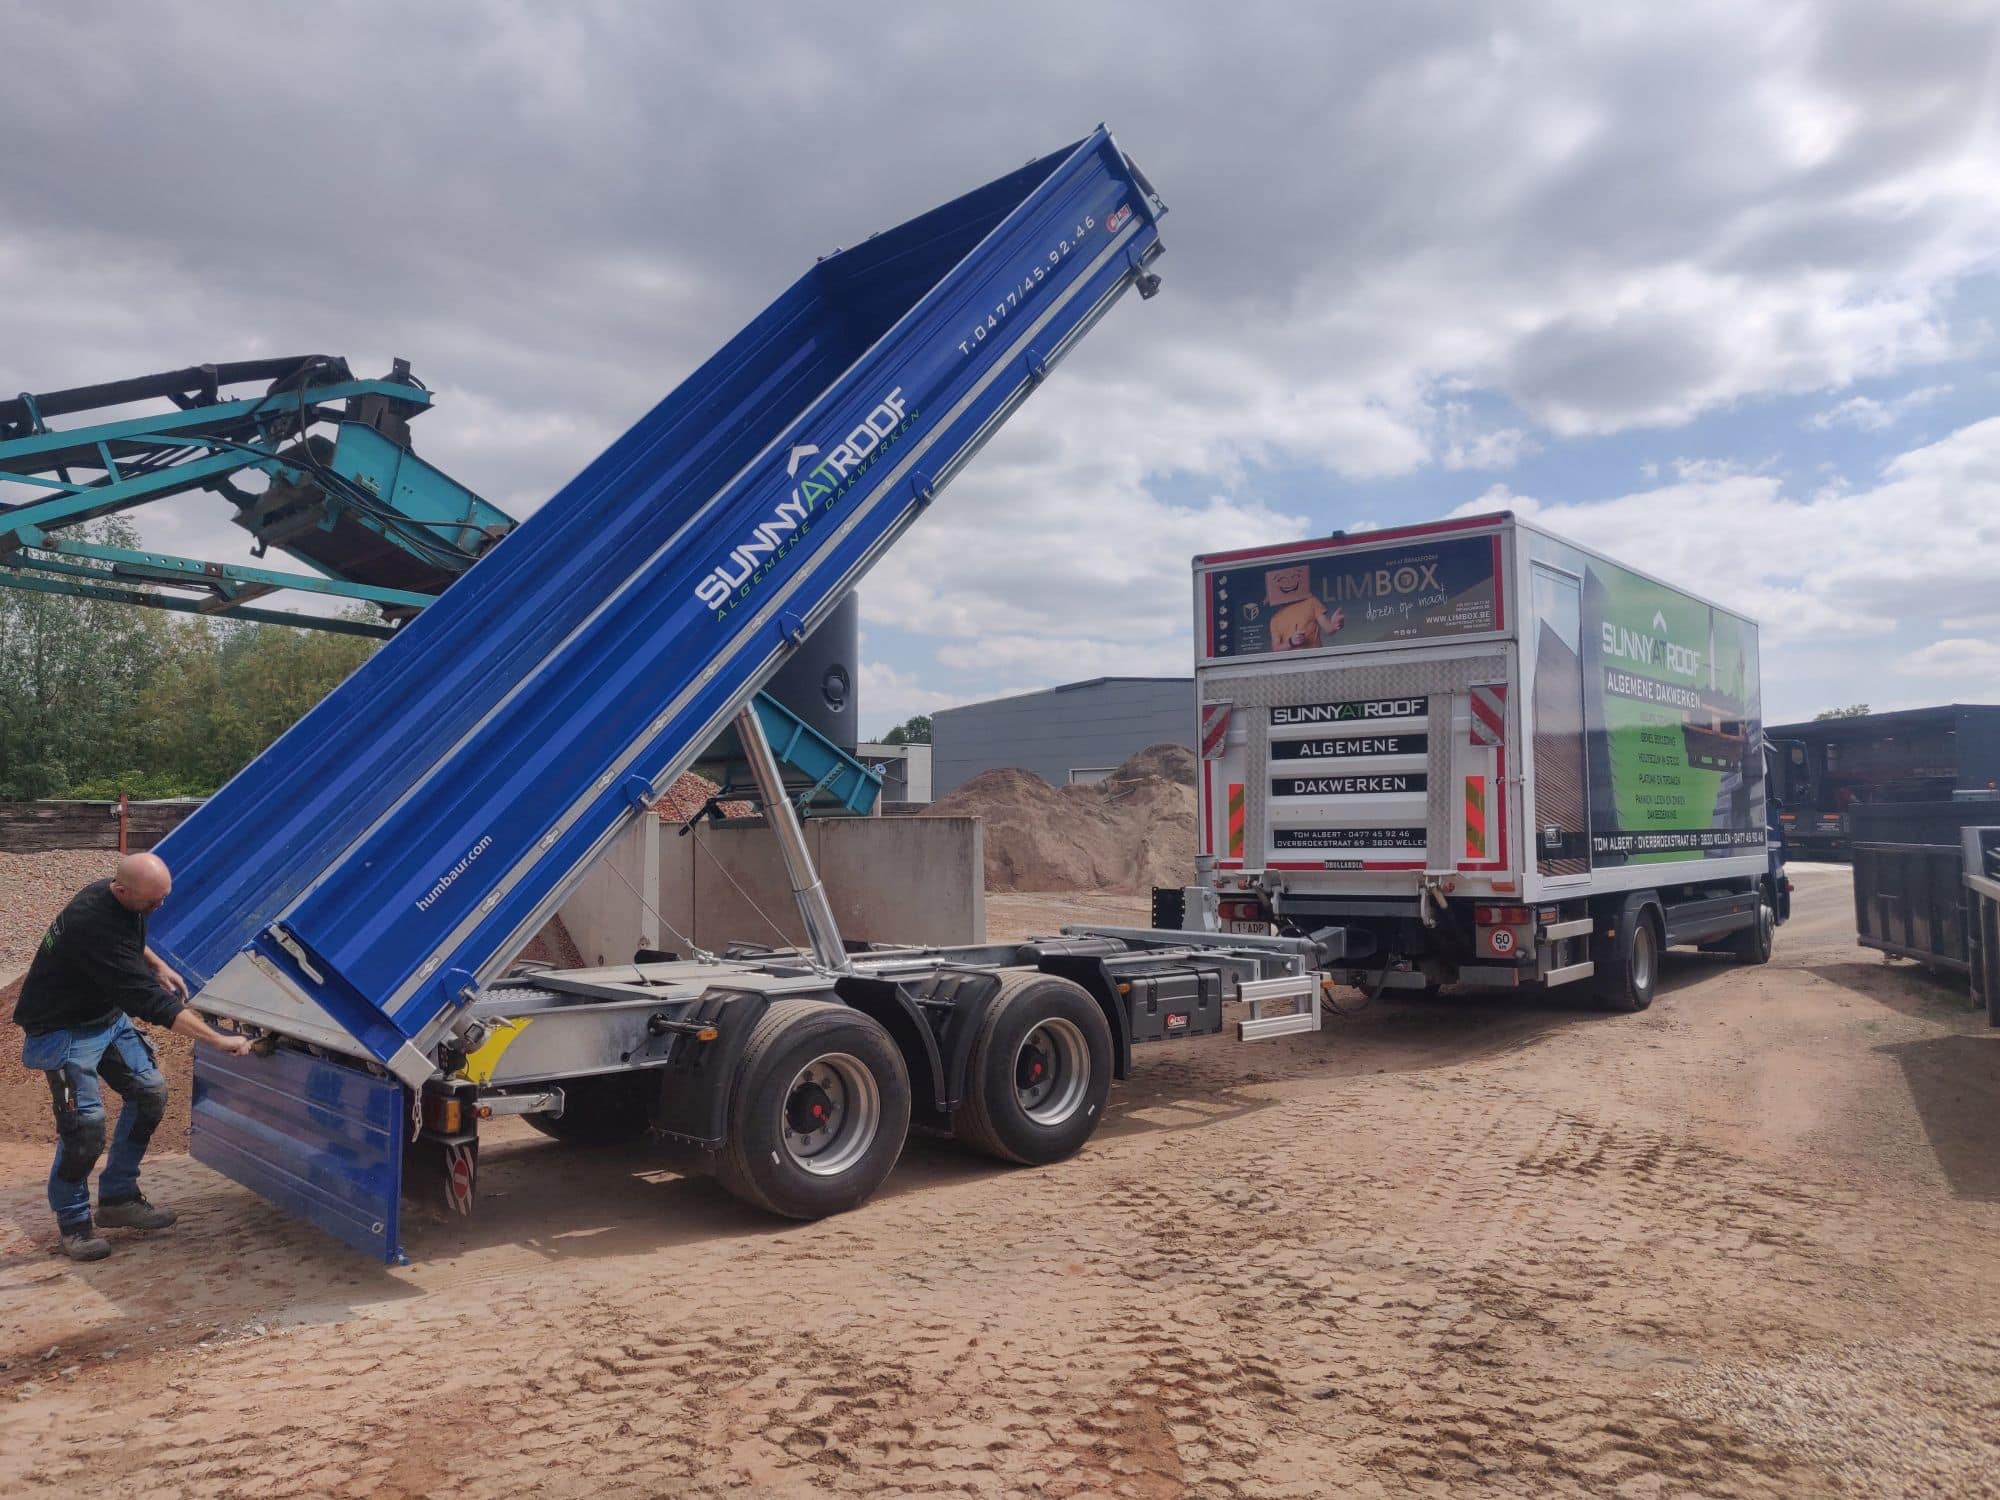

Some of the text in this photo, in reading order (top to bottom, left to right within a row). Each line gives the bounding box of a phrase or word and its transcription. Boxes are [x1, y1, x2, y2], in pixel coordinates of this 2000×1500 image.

[694, 385, 906, 611] SUNNYATROOF
[715, 409, 921, 622] ALGEMENE DAKWERKEN
[1322, 563, 1440, 601] LIMBOX
[1602, 621, 1701, 678] SUNNYATROOF
[1607, 671, 1701, 709] ALGEMENE DAKWERKEN
[1273, 699, 1425, 723] SUNNYATROOF
[1299, 738, 1399, 755] ALGEMENE
[1294, 777, 1407, 794] DAKWERKEN
[1372, 830, 1383, 838] 45
[1593, 836, 1608, 851] TOM
[1609, 835, 1633, 851] ALBERT
[415, 835, 493, 912] humbaur.com
[1495, 933, 1510, 945] 60
